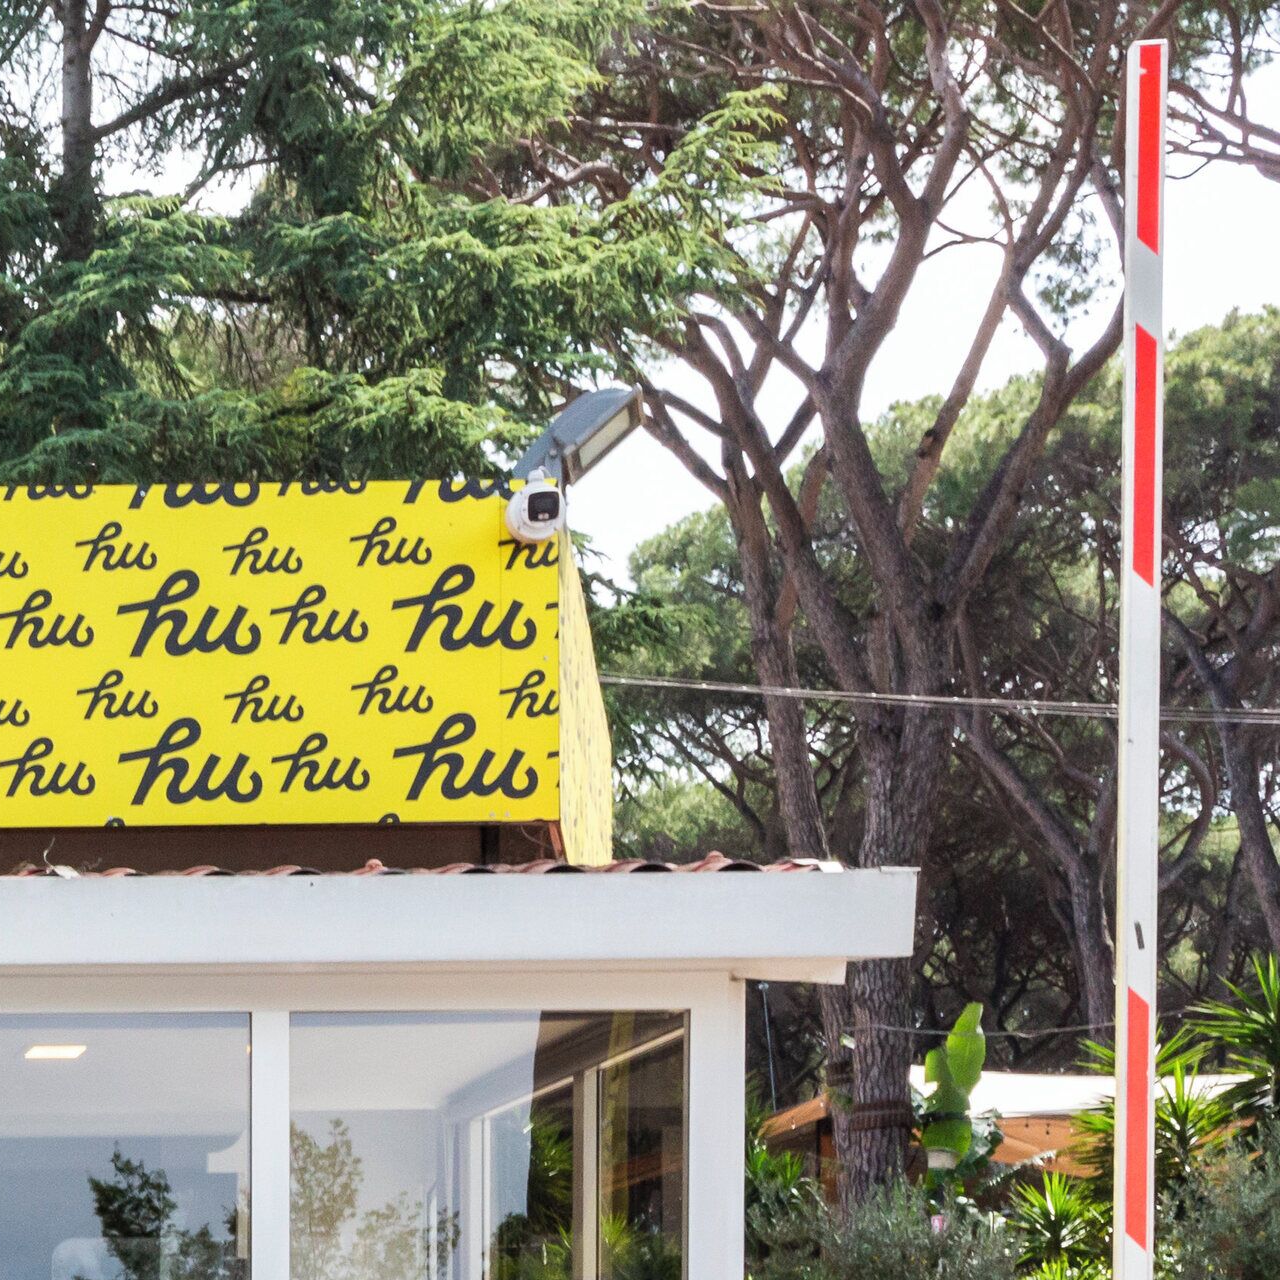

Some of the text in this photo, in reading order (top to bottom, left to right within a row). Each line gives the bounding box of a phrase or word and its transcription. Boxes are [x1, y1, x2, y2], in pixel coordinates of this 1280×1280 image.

[76, 522, 157, 570] hu
[223, 528, 302, 574] hu
[351, 517, 431, 566] hu
[117, 570, 261, 656] hu
[271, 585, 368, 644] hu
[392, 565, 536, 651] hu
[77, 670, 158, 719] hu
[225, 676, 303, 723] hu
[352, 665, 433, 714] hu
[119, 718, 262, 804] hu
[272, 733, 369, 792] hu
[394, 714, 538, 800] hu
